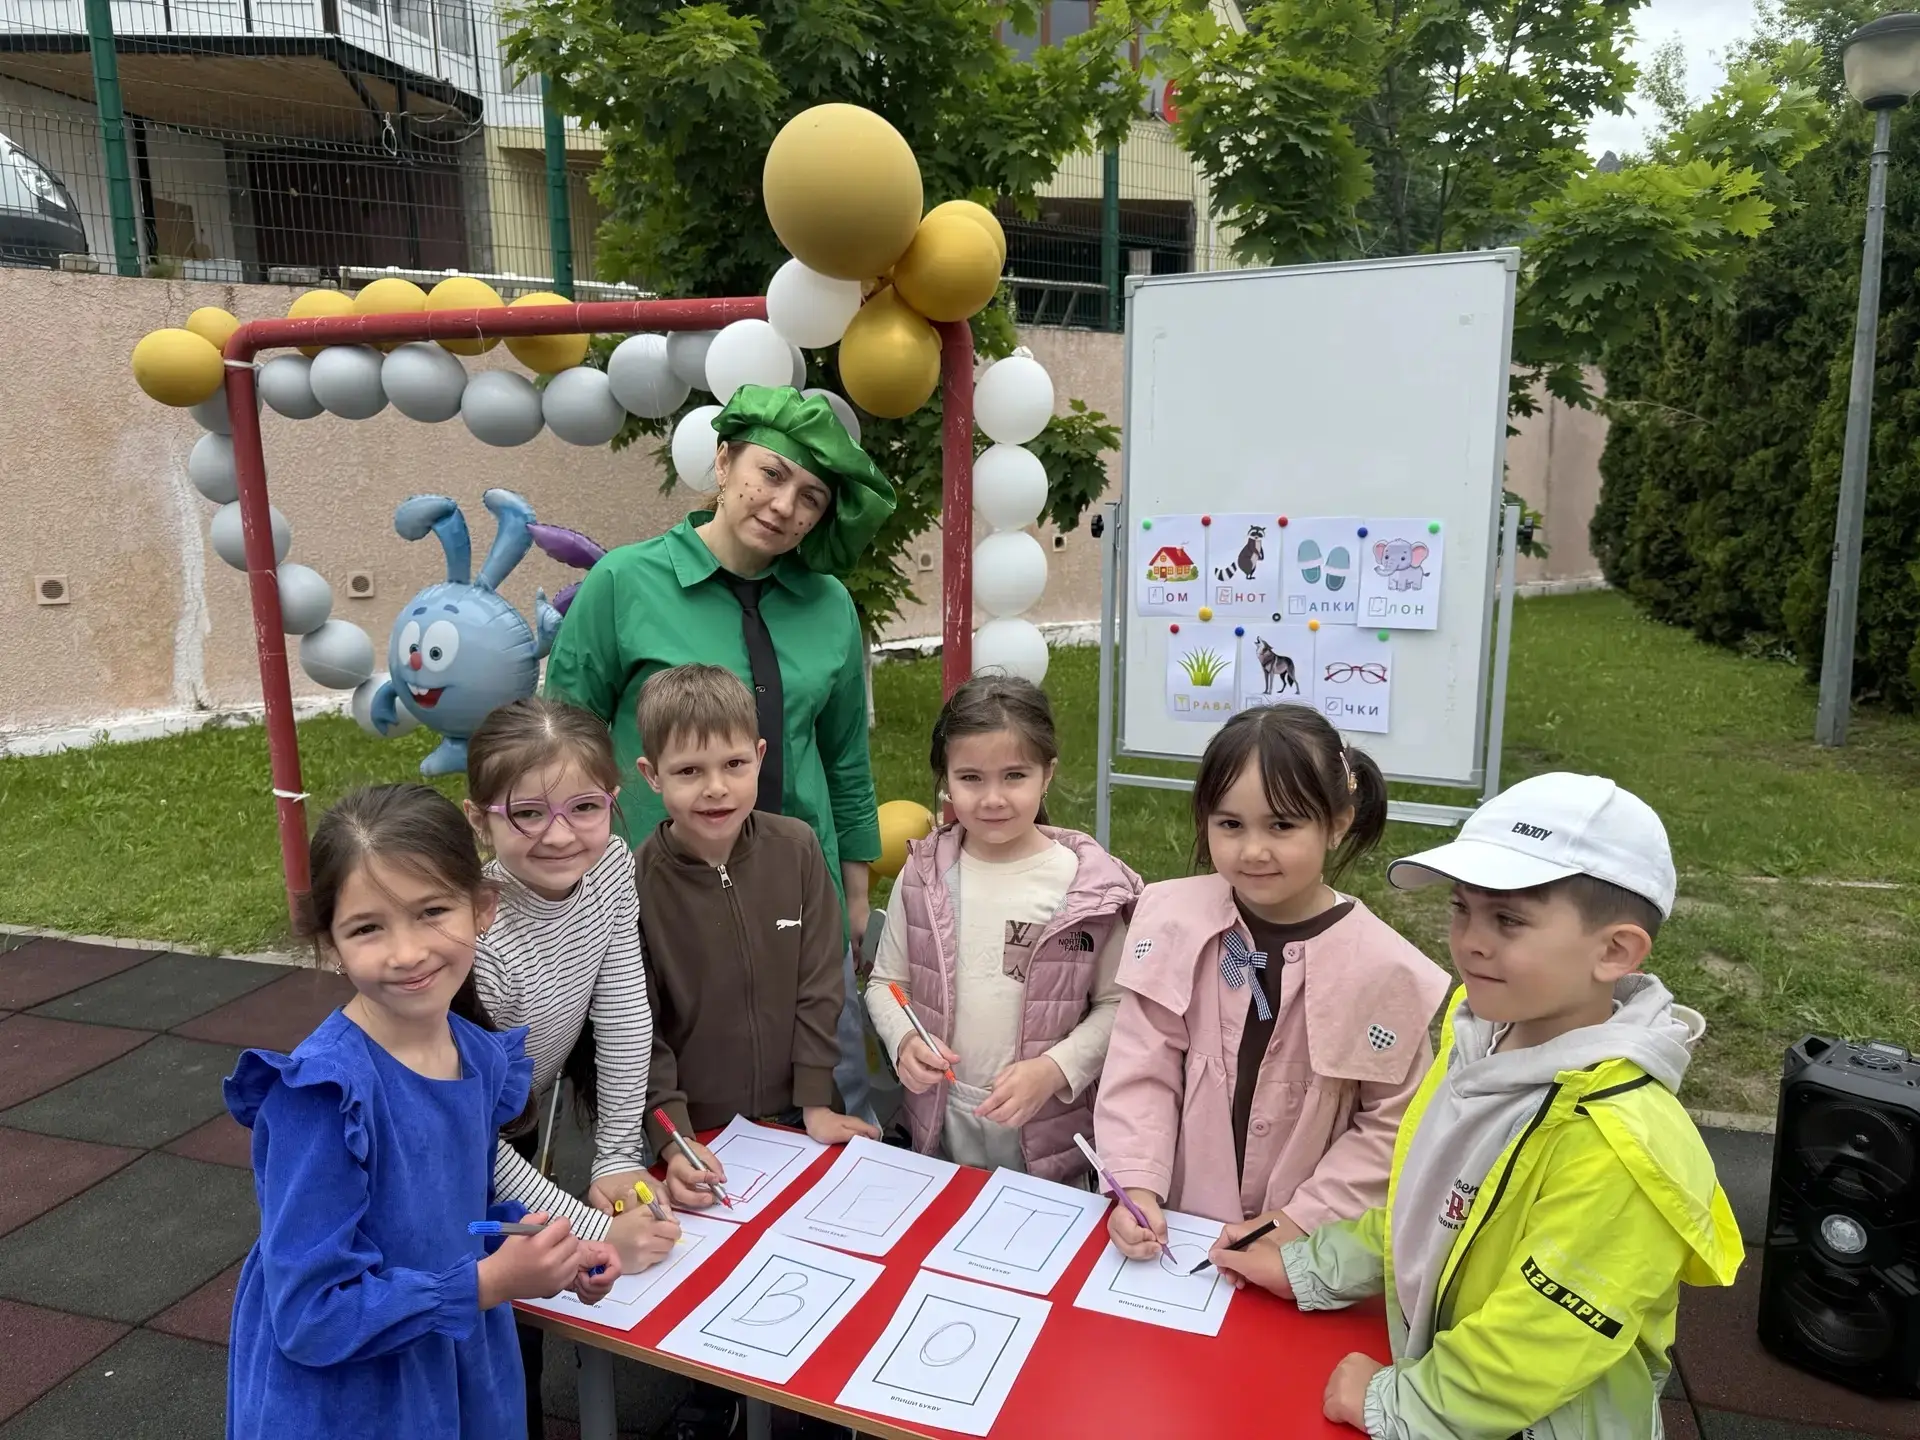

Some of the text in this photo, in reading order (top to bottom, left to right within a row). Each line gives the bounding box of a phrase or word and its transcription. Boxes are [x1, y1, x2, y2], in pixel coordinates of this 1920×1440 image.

[1325, 697, 1379, 716] ОЧКИ
[1511, 822, 1553, 841] ENJOY
[1524, 1263, 1559, 1296] 120
[1559, 1292, 1607, 1329] MPH
[890, 1395, 942, 1412] ВПИШИ БУКВУ
